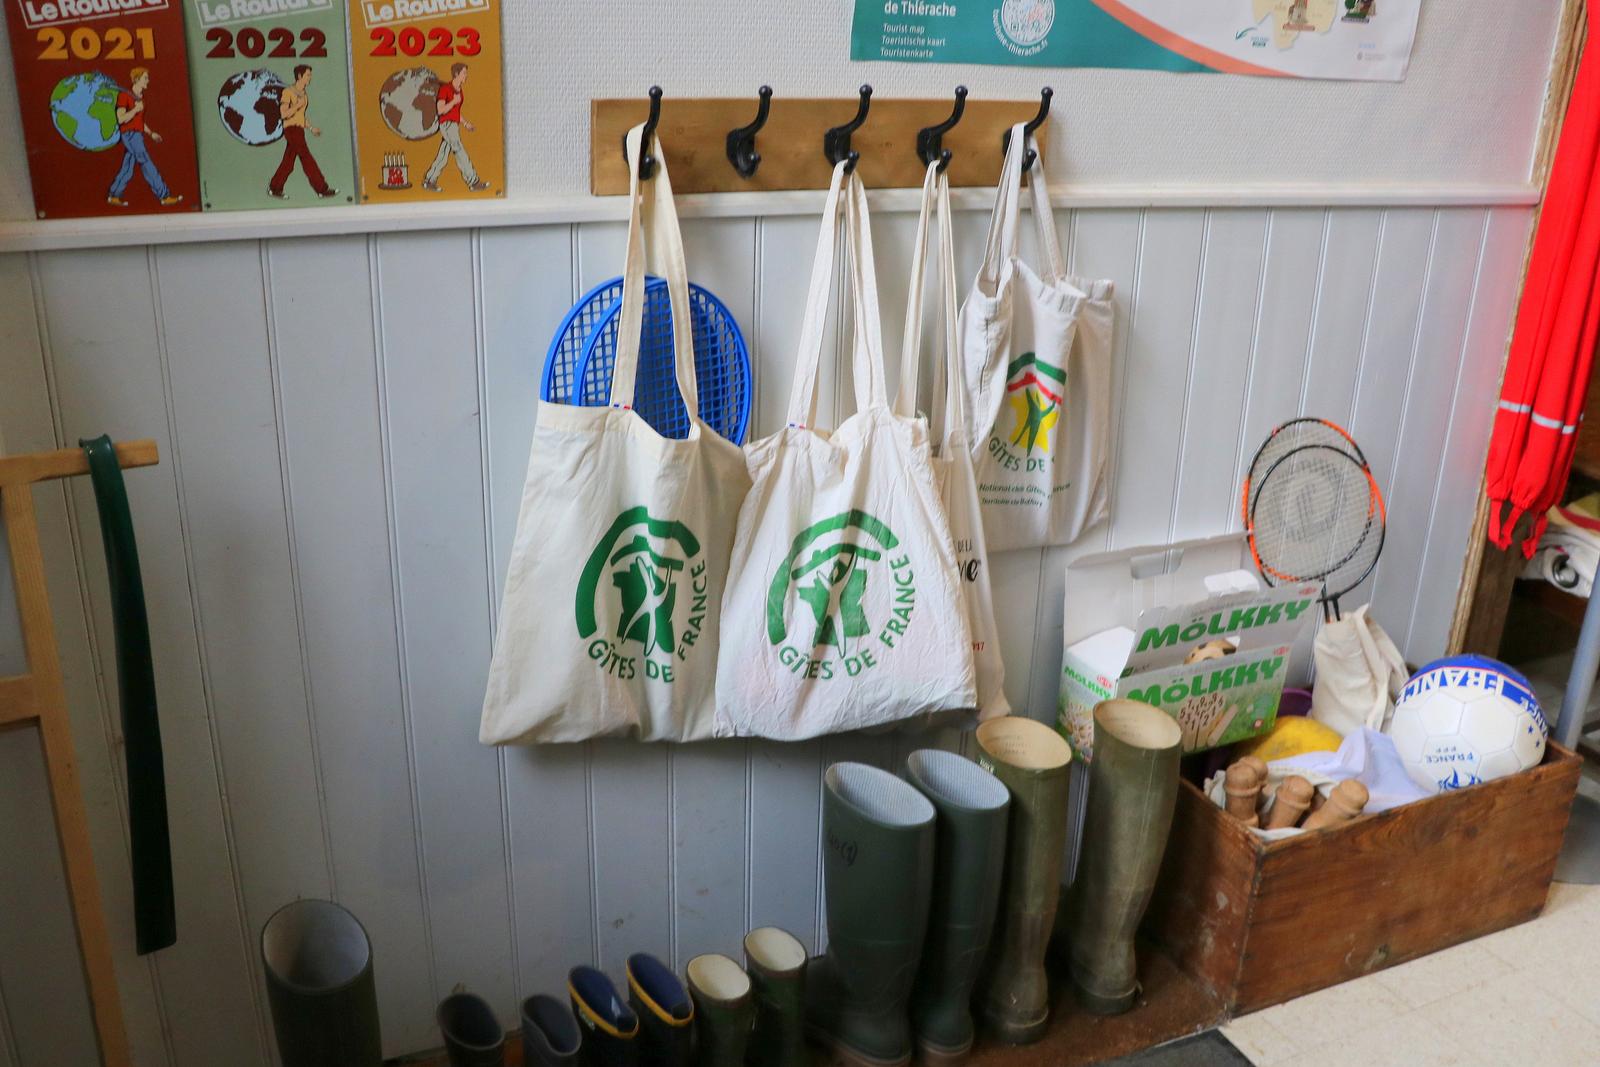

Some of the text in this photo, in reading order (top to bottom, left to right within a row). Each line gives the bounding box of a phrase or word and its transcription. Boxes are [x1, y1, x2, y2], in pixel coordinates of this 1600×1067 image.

[37, 27, 156, 60] 2021
[205, 27, 328, 58] 2022
[369, 27, 482, 57] 2023
[883, 23, 925, 35] Tourist map
[880, 47, 934, 58] Touristenkarte
[1026, 458, 1046, 472] DE
[588, 560, 707, 683] GÎTES DE FRANCE
[779, 554, 916, 680] GÎTES DE FRANCE
